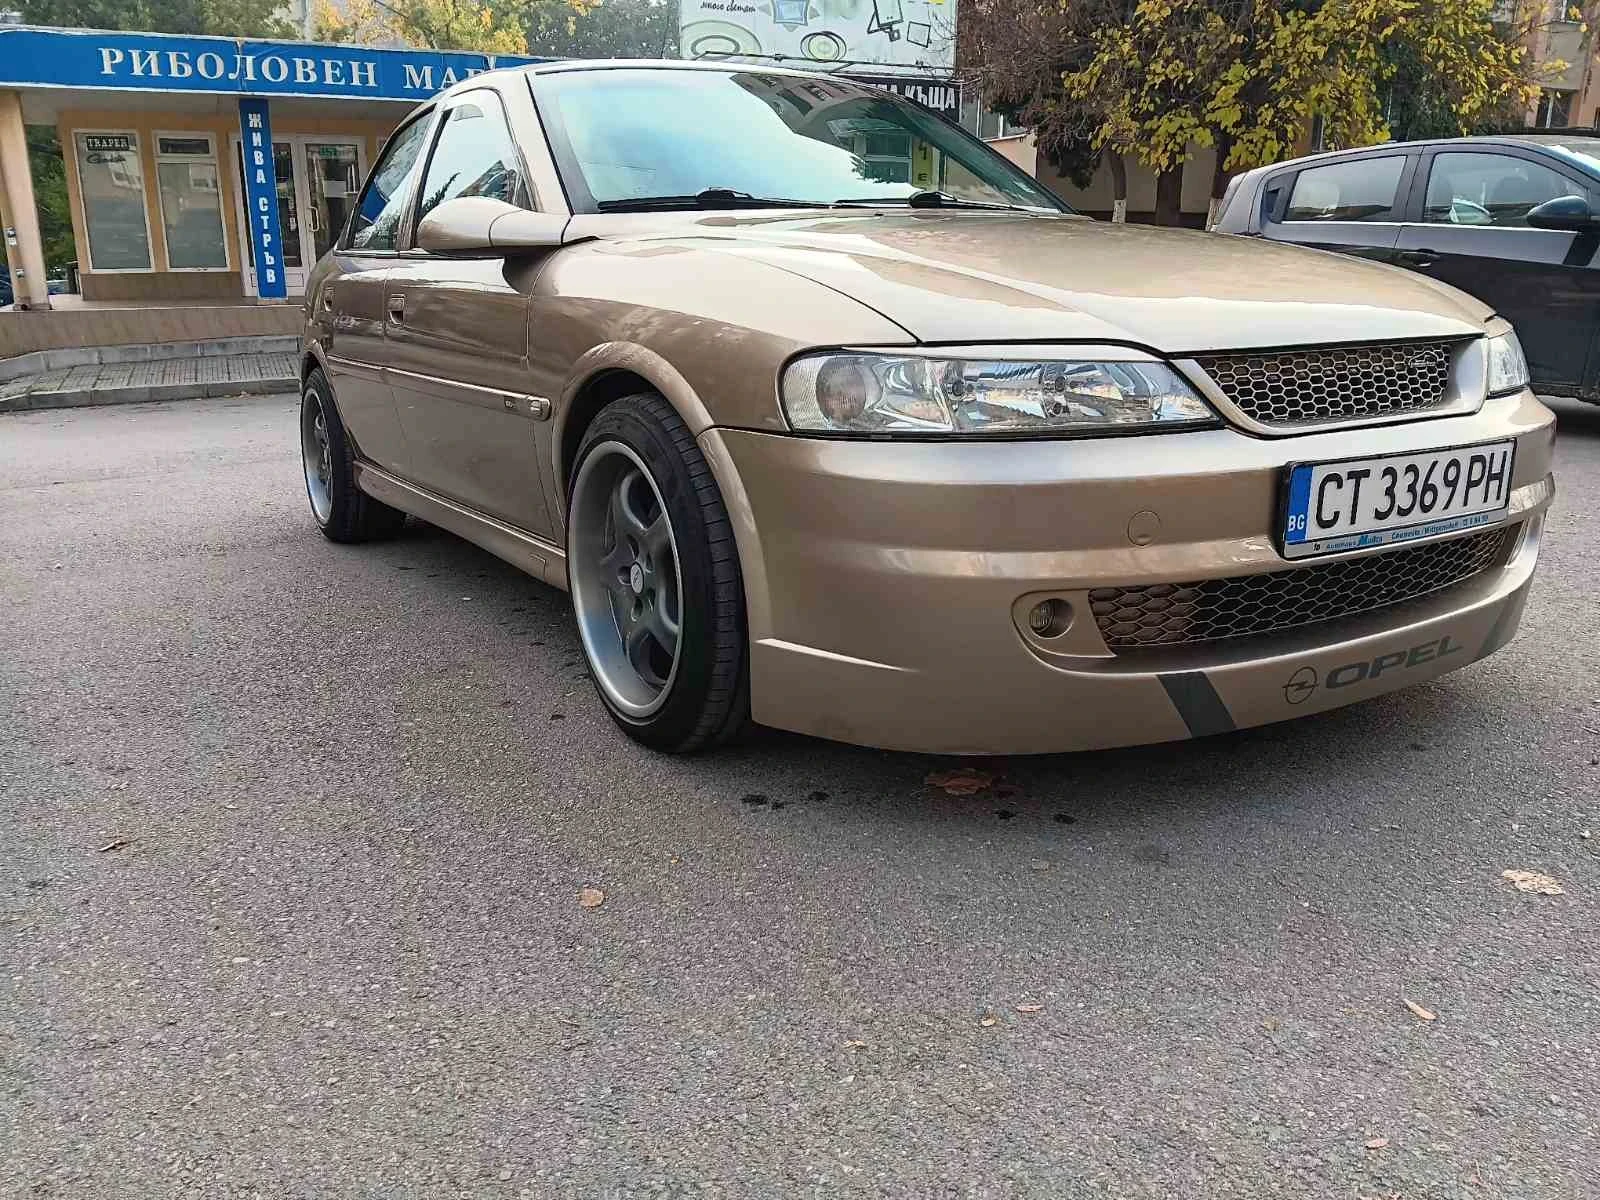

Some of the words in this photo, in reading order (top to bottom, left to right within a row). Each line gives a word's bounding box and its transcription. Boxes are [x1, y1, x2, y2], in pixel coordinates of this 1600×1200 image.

[98, 47, 379, 88] РИБОЛОВЕН
[904, 84, 956, 111] КЪЩА
[248, 113, 266, 184] ЖИВА
[258, 197, 277, 283] СТРЪВ
[1315, 468, 1371, 529] CT
[1373, 459, 1462, 520] 3369
[1287, 513, 1306, 532] BG
[1325, 635, 1464, 690] OPEL
